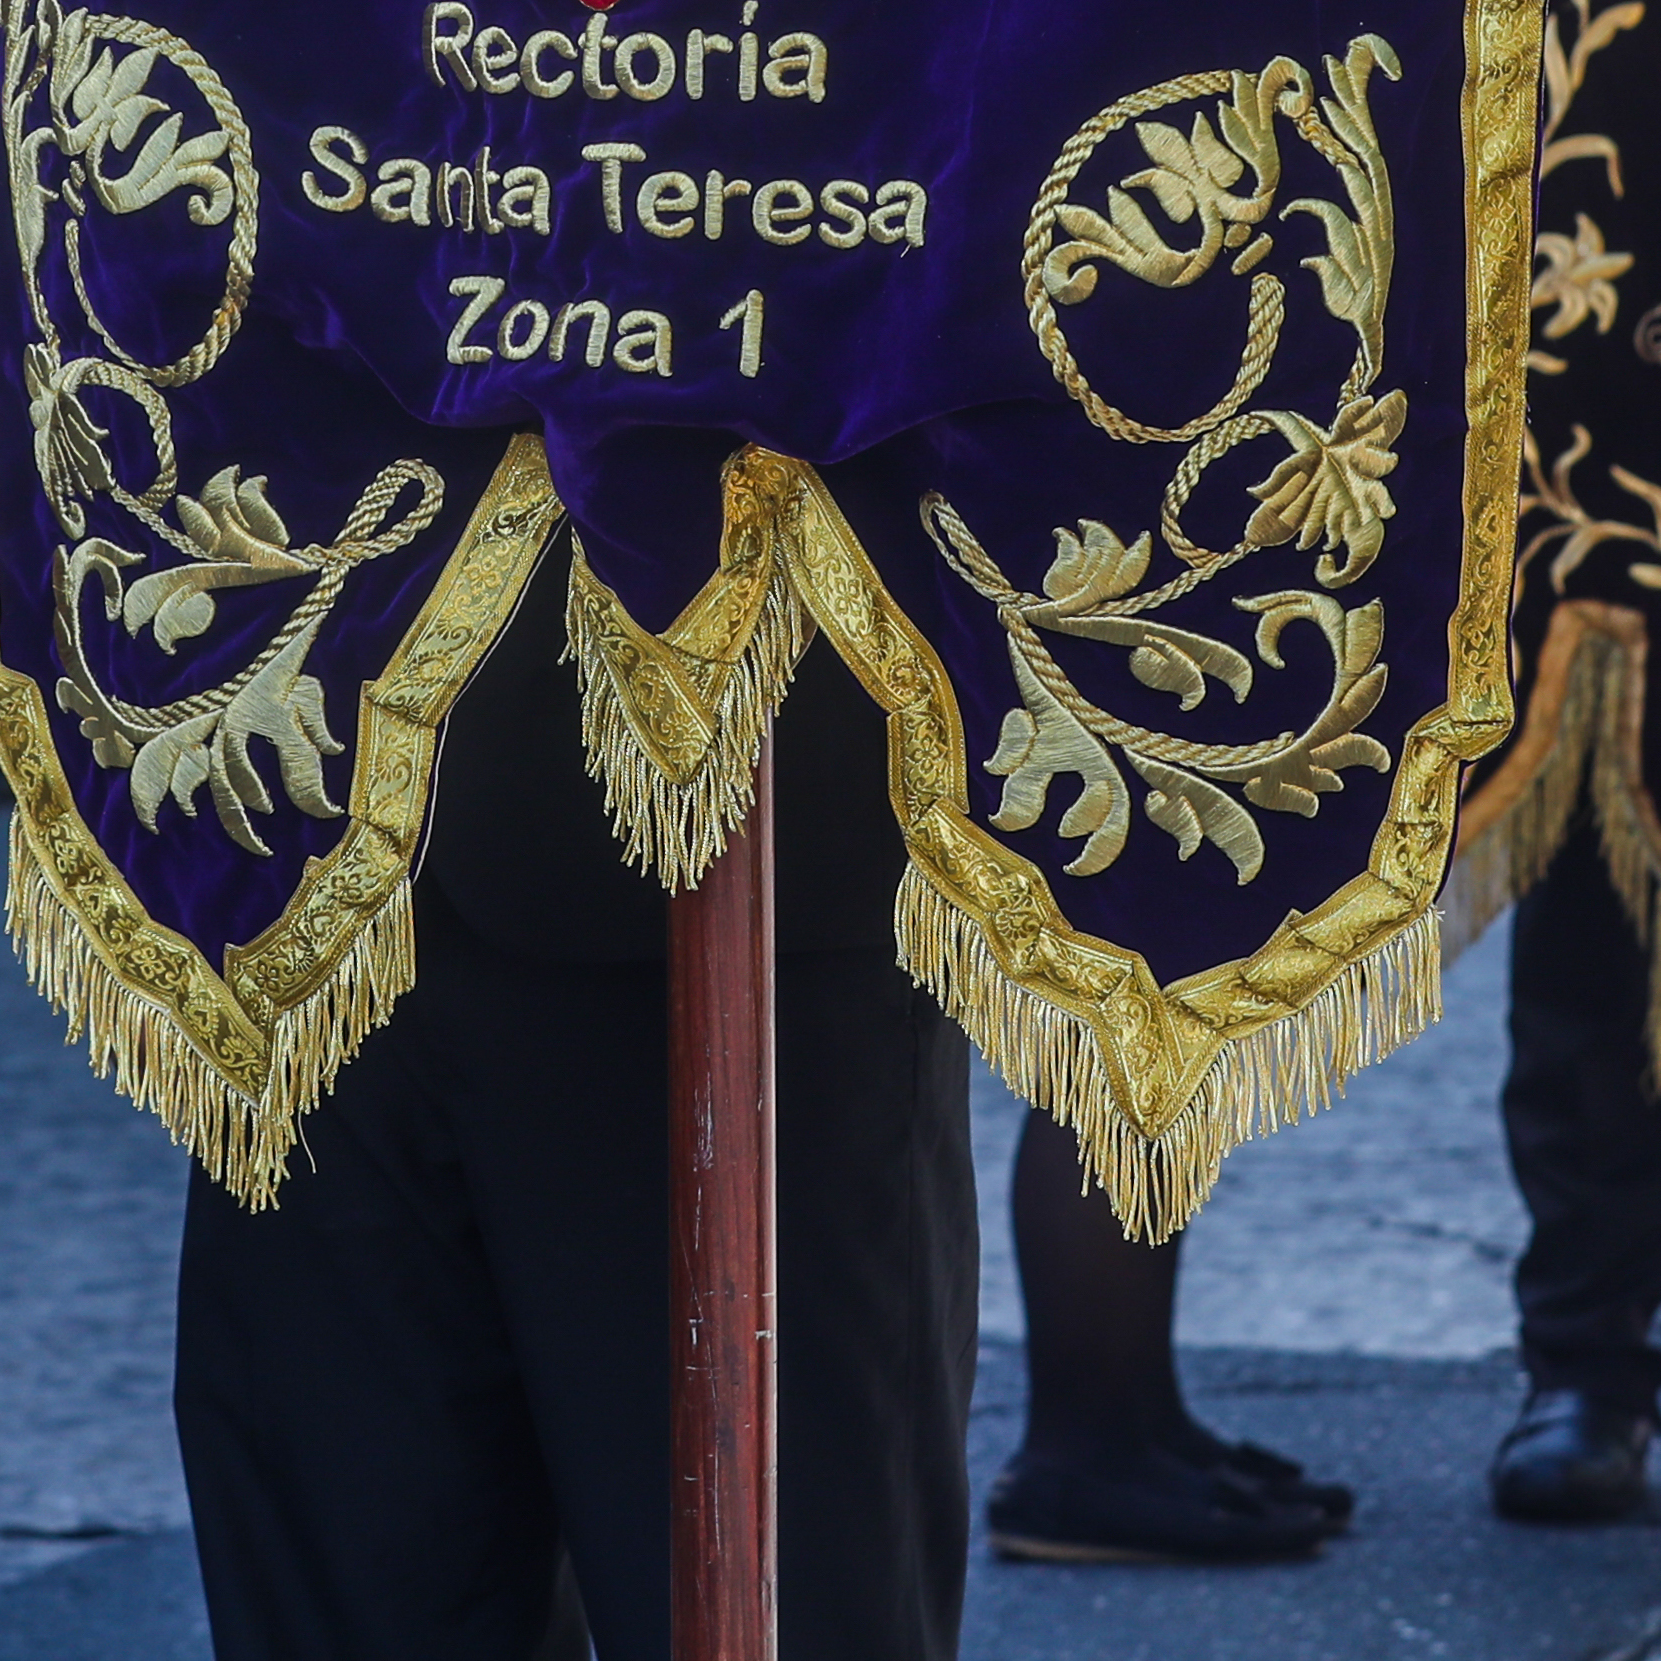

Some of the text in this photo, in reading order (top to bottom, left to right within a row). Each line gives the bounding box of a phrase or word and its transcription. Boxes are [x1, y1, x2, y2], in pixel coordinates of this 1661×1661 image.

[426, 0, 827, 103] Rectoría
[302, 126, 927, 248] Santa Teresa
[447, 276, 763, 377] Zona 1
